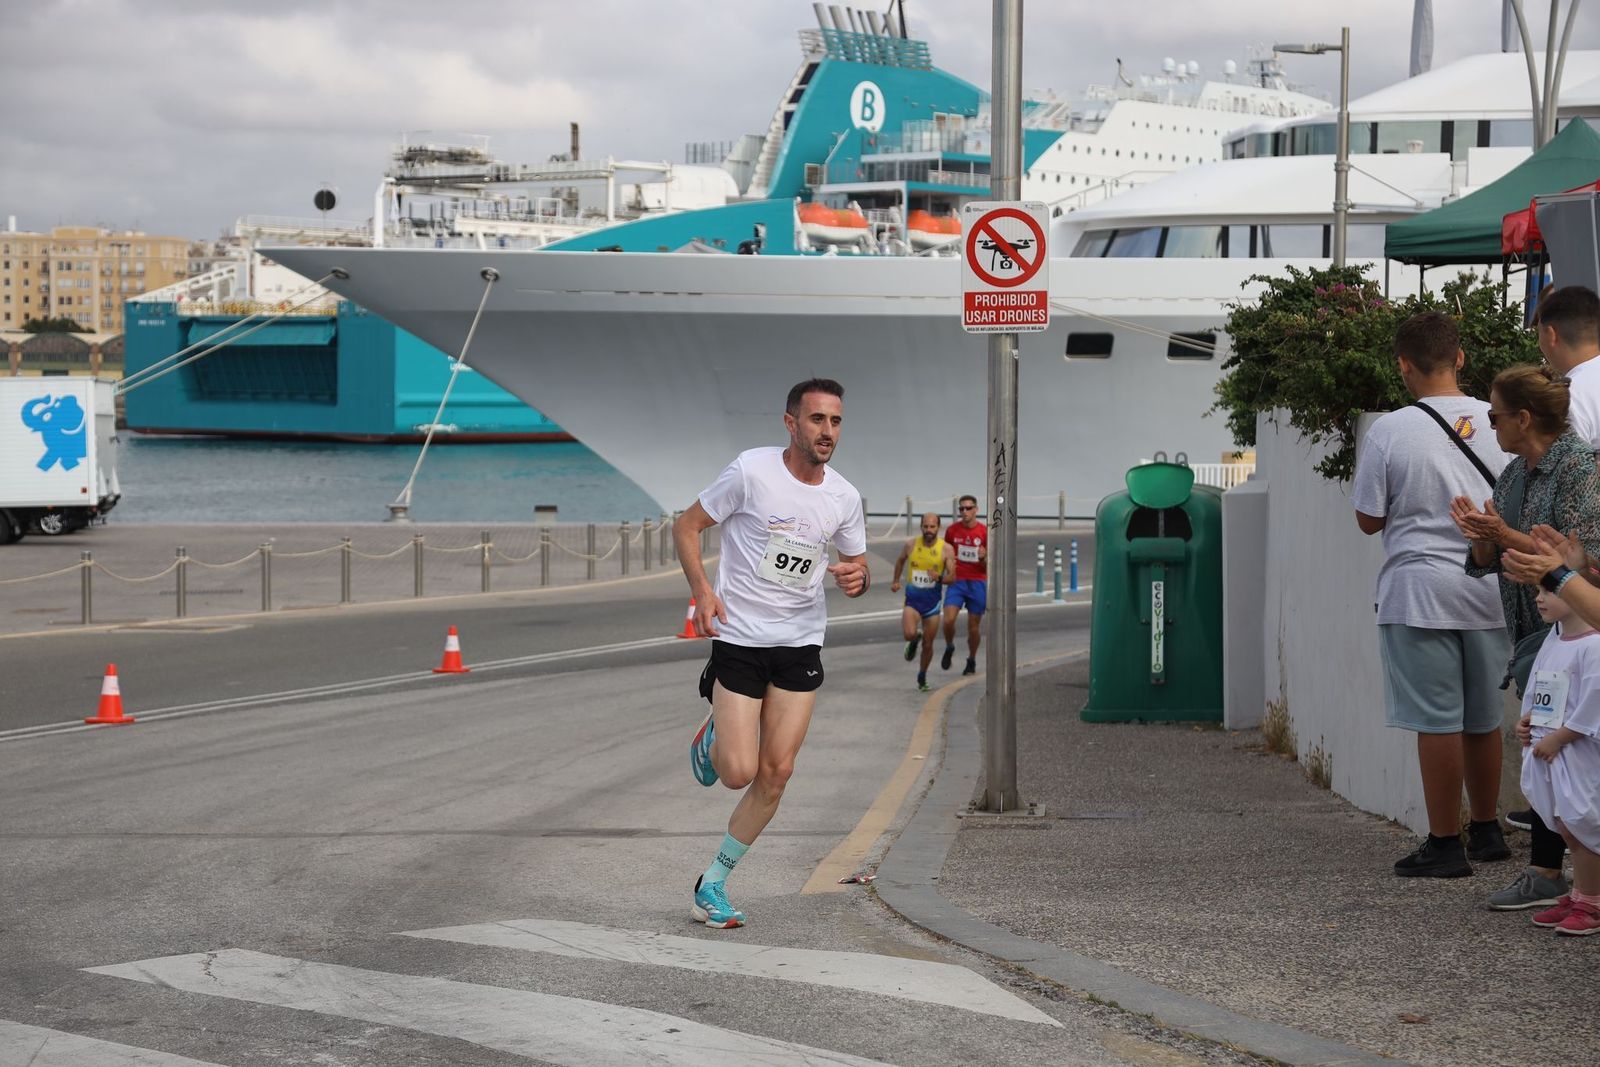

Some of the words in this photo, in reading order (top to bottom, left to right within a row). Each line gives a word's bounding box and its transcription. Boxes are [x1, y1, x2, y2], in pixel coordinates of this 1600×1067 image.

[861, 89, 875, 121] B
[975, 294, 1037, 306] PROHIBIDO
[966, 310, 996, 323] USAR
[1000, 309, 1046, 322] DRONES
[961, 550, 976, 558] 425
[774, 552, 812, 574] 978
